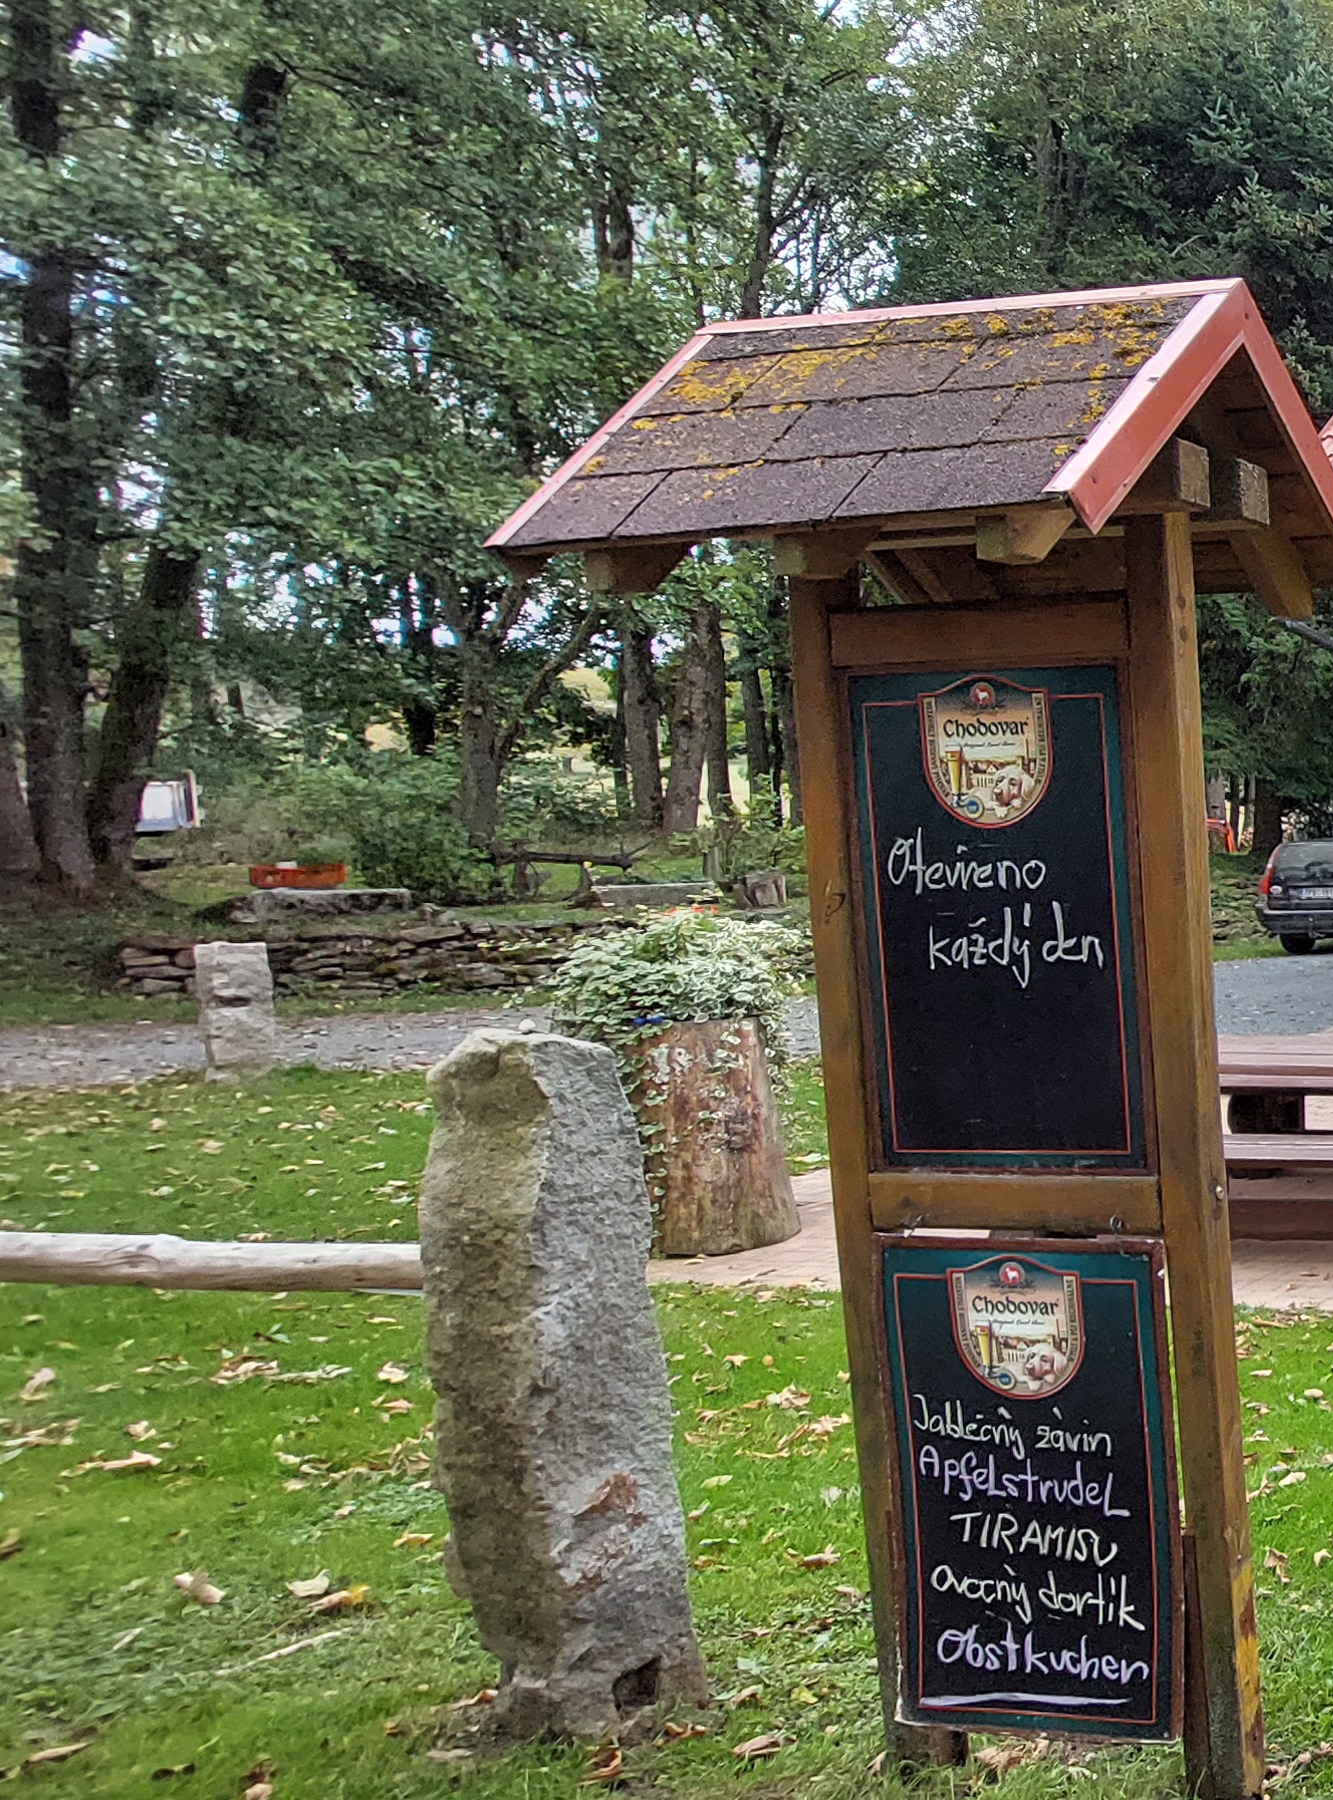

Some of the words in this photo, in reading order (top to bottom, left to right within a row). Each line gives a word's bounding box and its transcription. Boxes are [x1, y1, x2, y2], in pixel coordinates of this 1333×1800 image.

[943, 717, 1029, 740] Chodovar
[929, 902, 1031, 988] každý
[1042, 900, 1104, 969] den
[972, 1295, 1058, 1318] Chodovar
[950, 1511, 1118, 1567] TIRAMISU
[937, 1620, 1150, 1685] Obstkuchen
